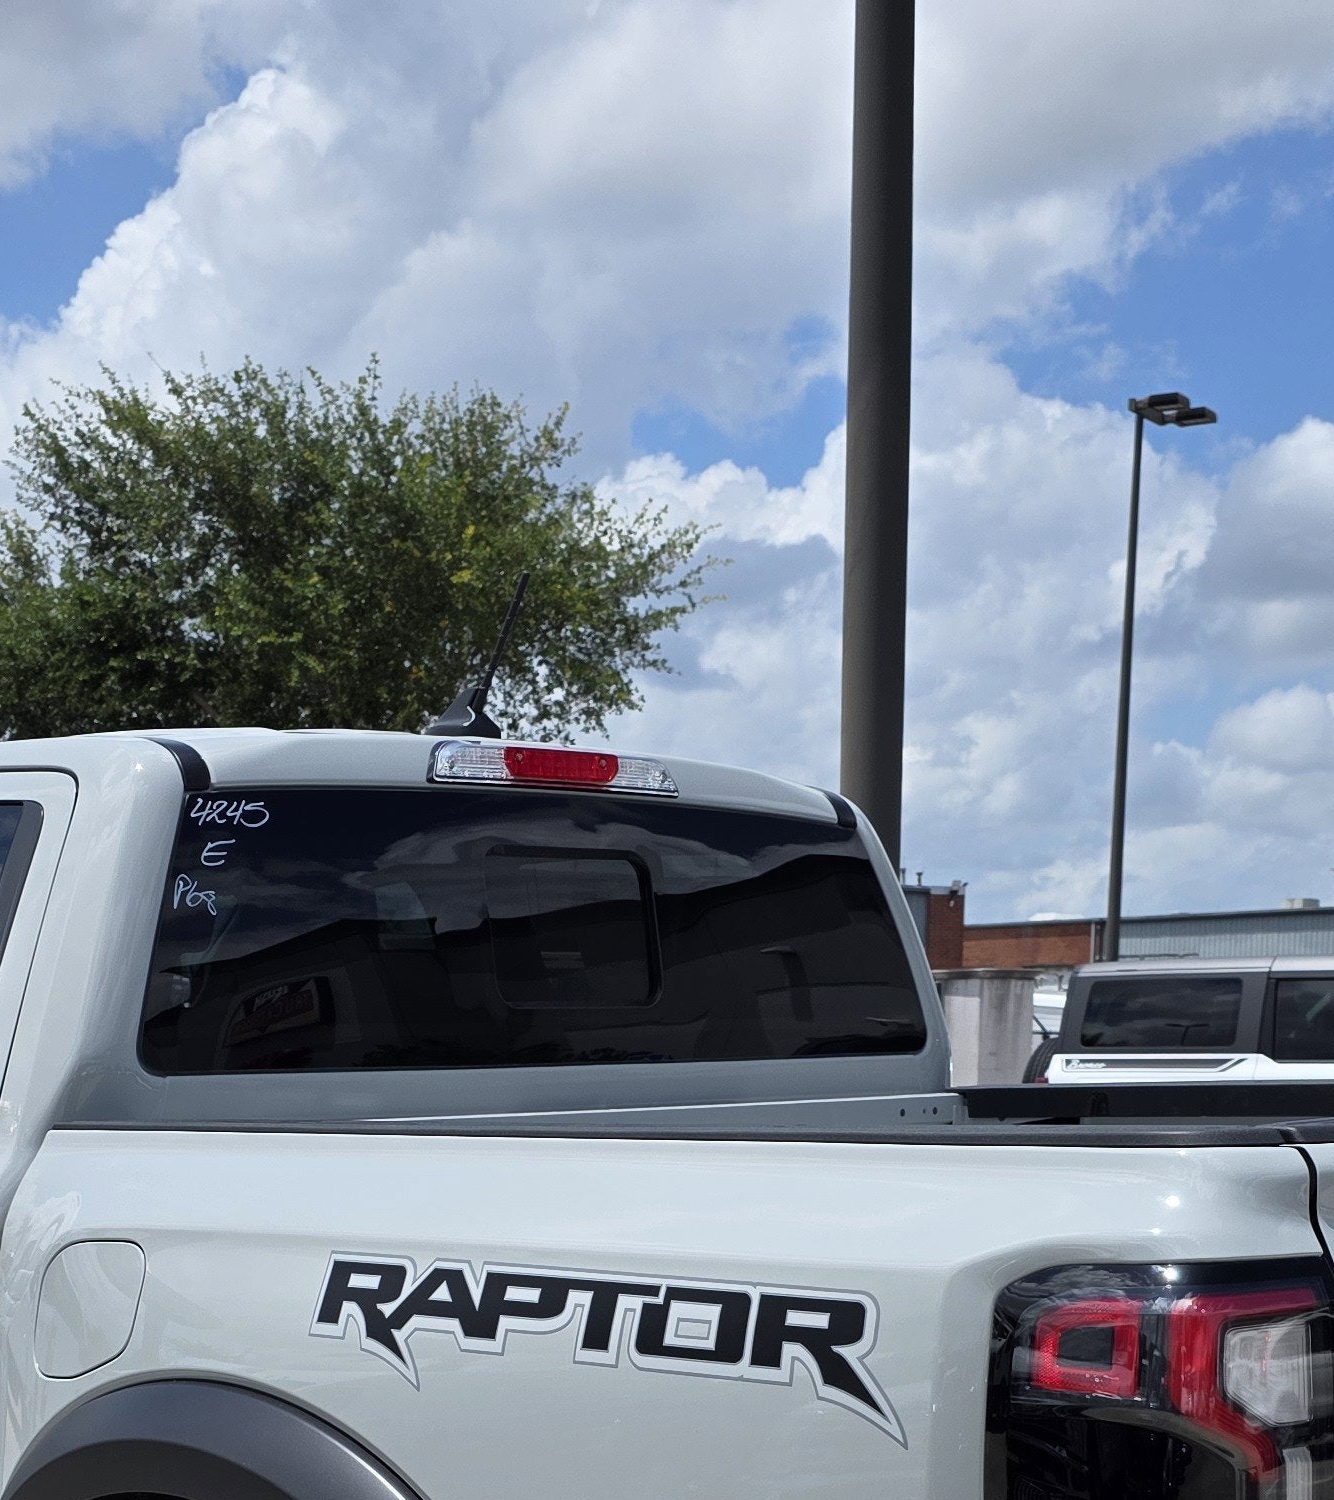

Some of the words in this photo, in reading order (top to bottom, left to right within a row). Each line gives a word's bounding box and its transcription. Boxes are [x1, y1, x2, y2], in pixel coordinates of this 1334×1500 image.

[190, 797, 271, 829] 4245
[200, 838, 236, 867] E
[310, 1252, 906, 1448] RAPTOR
